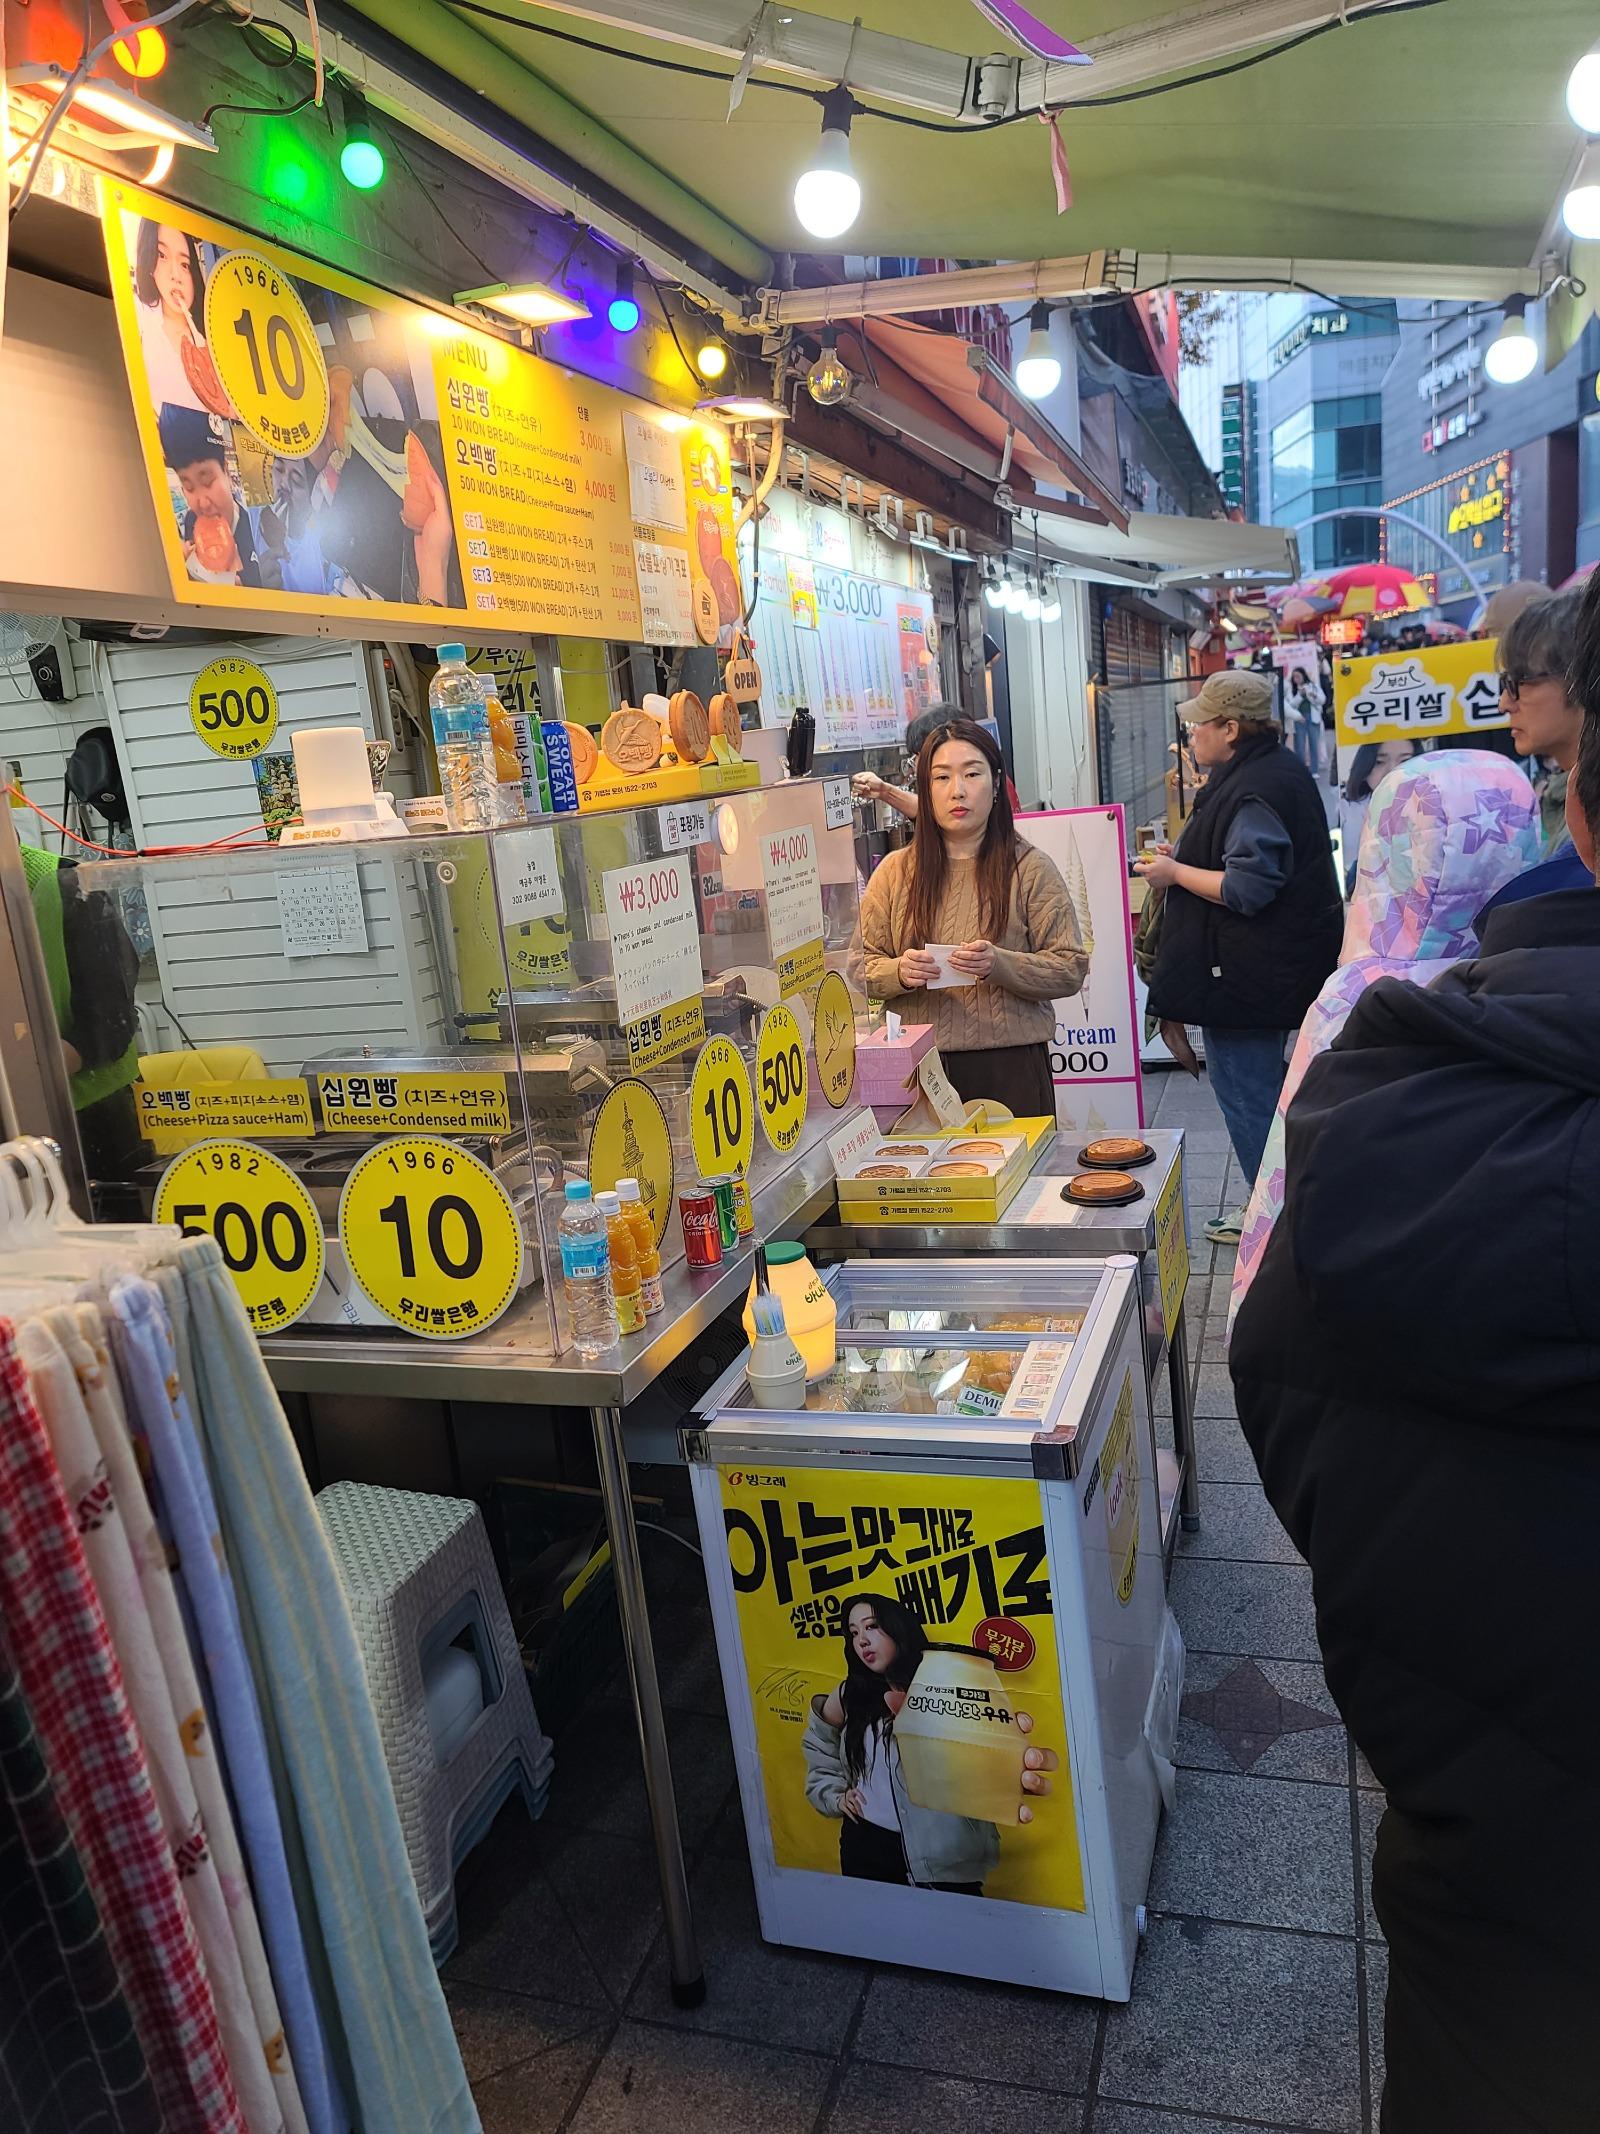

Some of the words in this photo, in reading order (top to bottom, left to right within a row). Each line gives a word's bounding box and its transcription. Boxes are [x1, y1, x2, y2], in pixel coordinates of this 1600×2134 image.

[234, 265, 279, 296] 1966
[234, 308, 305, 400] 10
[442, 338, 488, 372] MENU
[447, 377, 490, 418] 십원빵
[577, 405, 590, 422] 단품
[260, 415, 310, 445] 우리쌀은행
[451, 414, 463, 431] 10
[464, 419, 486, 438] WON
[580, 430, 602, 452] 3,000
[456, 438, 497, 476] 오백빵
[460, 475, 476, 492] 500
[477, 478, 498, 498] WON
[585, 482, 607, 499] 4,000
[608, 485, 617, 502] 원
[464, 513, 485, 529] SET1
[516, 524, 533, 540] WON
[468, 541, 489, 557] SET2
[519, 549, 536, 564] WON
[473, 567, 492, 583] SET3
[526, 575, 541, 590] WON
[477, 594, 496, 609] SET4
[814, 575, 881, 617] ₩3,000
[530, 601, 545, 616] WON
[212, 663, 245, 677] 1982
[734, 671, 757, 689] OPEN
[1388, 676, 1408, 688] 부산
[199, 686, 270, 731] 500
[1351, 692, 1447, 726] 우리쌀
[514, 720, 533, 780] 데미소다
[546, 735, 567, 803] SWEAT
[558, 734, 577, 810] POCARI
[624, 782, 658, 794] 1522-2703
[680, 814, 705, 832] 포장가능
[770, 833, 808, 869] ₩4,000
[619, 868, 679, 915] ₩3,000
[636, 926, 652, 936] cheese
[653, 920, 661, 930] and
[663, 912, 684, 927] condensed
[779, 958, 795, 979] 오백빵
[628, 1013, 662, 1053] 십원빵
[768, 1012, 788, 1034] 1982
[1052, 1023, 1116, 1047] Cream
[632, 1033, 690, 1073] (Cheese+Condensed
[690, 1023, 705, 1042] milk)
[705, 1047, 729, 1071] 1966
[762, 1043, 803, 1114] 500
[832, 1068, 848, 1093] 오백빵
[142, 1090, 191, 1111] 오백빵
[321, 1078, 398, 1108] 십원빵
[405, 1089, 506, 1108] (치즈+연유)
[143, 1112, 230, 1129] (Cheese+Pizza
[232, 1111, 308, 1128] sauce+Ham)
[327, 1111, 467, 1128] (Cheese+Condensed
[470, 1111, 507, 1130] milk)
[704, 1077, 742, 1158] 10
[196, 1152, 260, 1177] 1982
[387, 1150, 456, 1177] 1966
[918, 1186, 952, 1194] 1522-2703
[379, 1194, 485, 1281] 10
[341, 1296, 362, 1327] TEEL
[398, 1296, 480, 1327] 우리쌀은행
[745, 1474, 787, 1488] 빙그레
[896, 1526, 1054, 1626] 빼기로
[790, 1595, 844, 1640] 설탕은
[985, 1628, 1025, 1653] 무가당
[989, 1642, 1015, 1662] 출시
[934, 1686, 955, 1695] 빙그레
[960, 1689, 986, 1700] 무가당
[907, 1696, 981, 1721] 바나나맛
